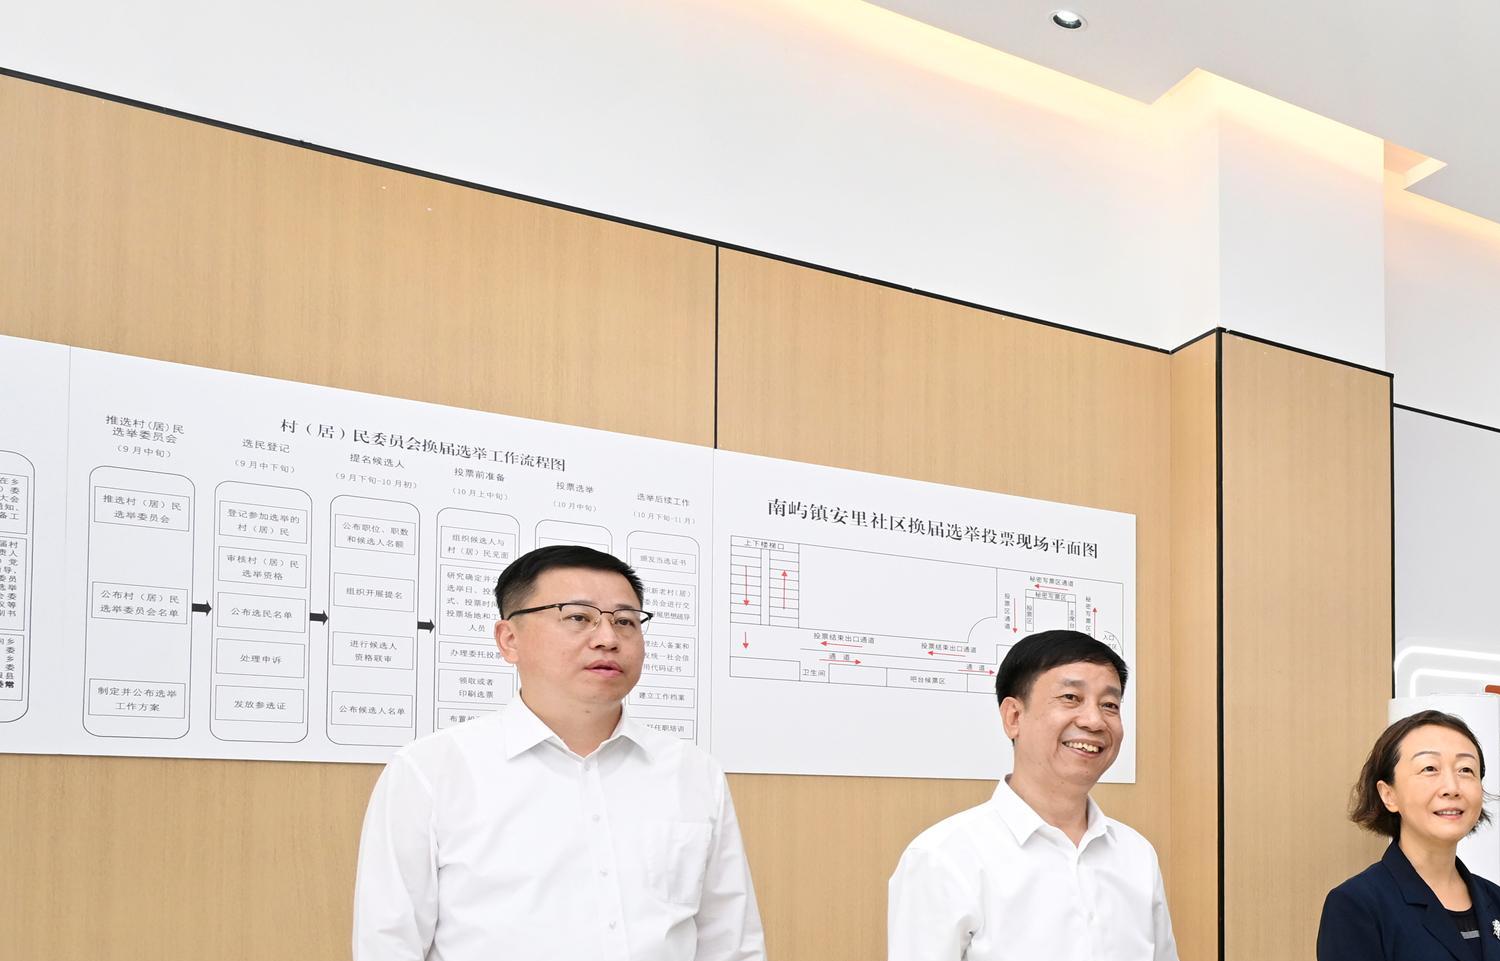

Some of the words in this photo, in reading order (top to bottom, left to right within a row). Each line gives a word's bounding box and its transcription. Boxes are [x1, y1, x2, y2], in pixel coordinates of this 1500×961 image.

[105, 415, 185, 434] 推选村（居）民
[113, 427, 177, 444] 选举委员会
[242, 438, 290, 454] 选民登记
[281, 417, 567, 472] 村（居）民委员会换届选举工作流程图
[350, 453, 405, 469] 提名候选人
[454, 467, 505, 483] 投票前准备
[556, 481, 594, 494] 投票选举
[103, 494, 181, 511] 推选村（居）民
[637, 492, 690, 508] 选举后续工作
[114, 510, 170, 524] 选举委员会
[227, 508, 300, 524] 登记参加选举的
[238, 524, 290, 537] 村（居）民
[342, 521, 409, 537] 公布职位、职数
[767, 498, 1098, 560] 南屿镇安里社区换届选举投票现场平面图
[452, 533, 505, 547] 组织候选人与
[226, 553, 299, 568] 审核村（居）民
[242, 568, 284, 581] 选举资格
[100, 589, 180, 604] 公布村（居）民
[346, 587, 403, 600] 组织开展提名
[100, 604, 179, 618] 选举委员会名单
[231, 607, 293, 620] 公布选民名单
[349, 639, 398, 651] 进行候选人
[240, 654, 282, 665] 处理申诉
[97, 686, 177, 698] 制定并公布选举
[115, 701, 161, 712] 工作方案
[339, 705, 406, 716] 公布候选人名单
